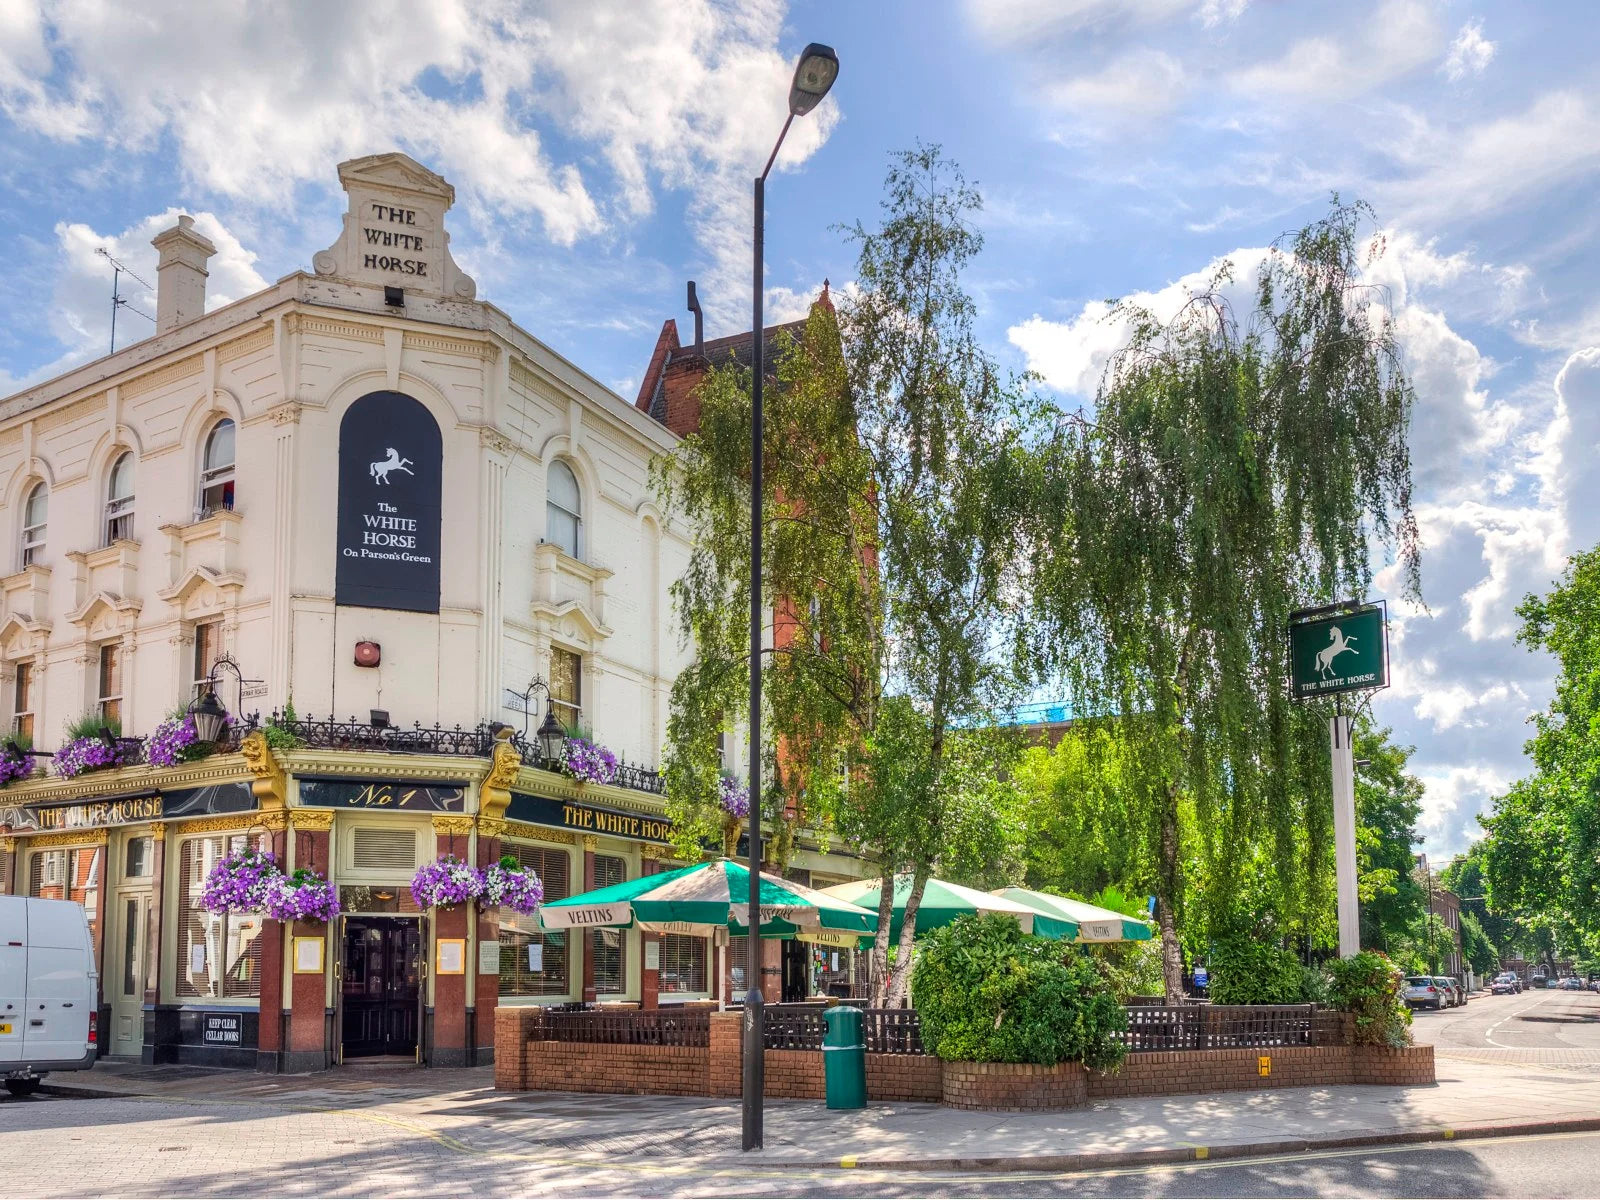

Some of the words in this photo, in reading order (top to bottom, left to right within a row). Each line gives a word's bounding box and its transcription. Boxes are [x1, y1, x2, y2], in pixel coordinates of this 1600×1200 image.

[372, 203, 416, 226] THE
[363, 227, 423, 252] WHITE
[363, 254, 428, 277] HORSE
[377, 502, 398, 513] The
[363, 514, 417, 532] WHITE
[362, 531, 416, 549] HORSE
[343, 547, 359, 557] On
[360, 548, 400, 561] Parson's
[401, 552, 432, 563] Green
[1301, 682, 1317, 691] THE
[1319, 678, 1345, 688] WHITE
[1347, 674, 1376, 684] HORSE
[349, 784, 393, 808] No
[400, 789, 418, 806] 1
[38, 808, 63, 828] THE
[112, 797, 164, 821] HORSE
[563, 805, 593, 828] THE
[595, 811, 639, 836] WHITE
[641, 820, 682, 841] HORS
[567, 908, 613, 924] VELTINS
[208, 1018, 221, 1029] KEEP
[221, 1018, 237, 1029] CLEAR
[205, 1030, 223, 1041] CELLAR
[224, 1031, 239, 1042] DOORS
